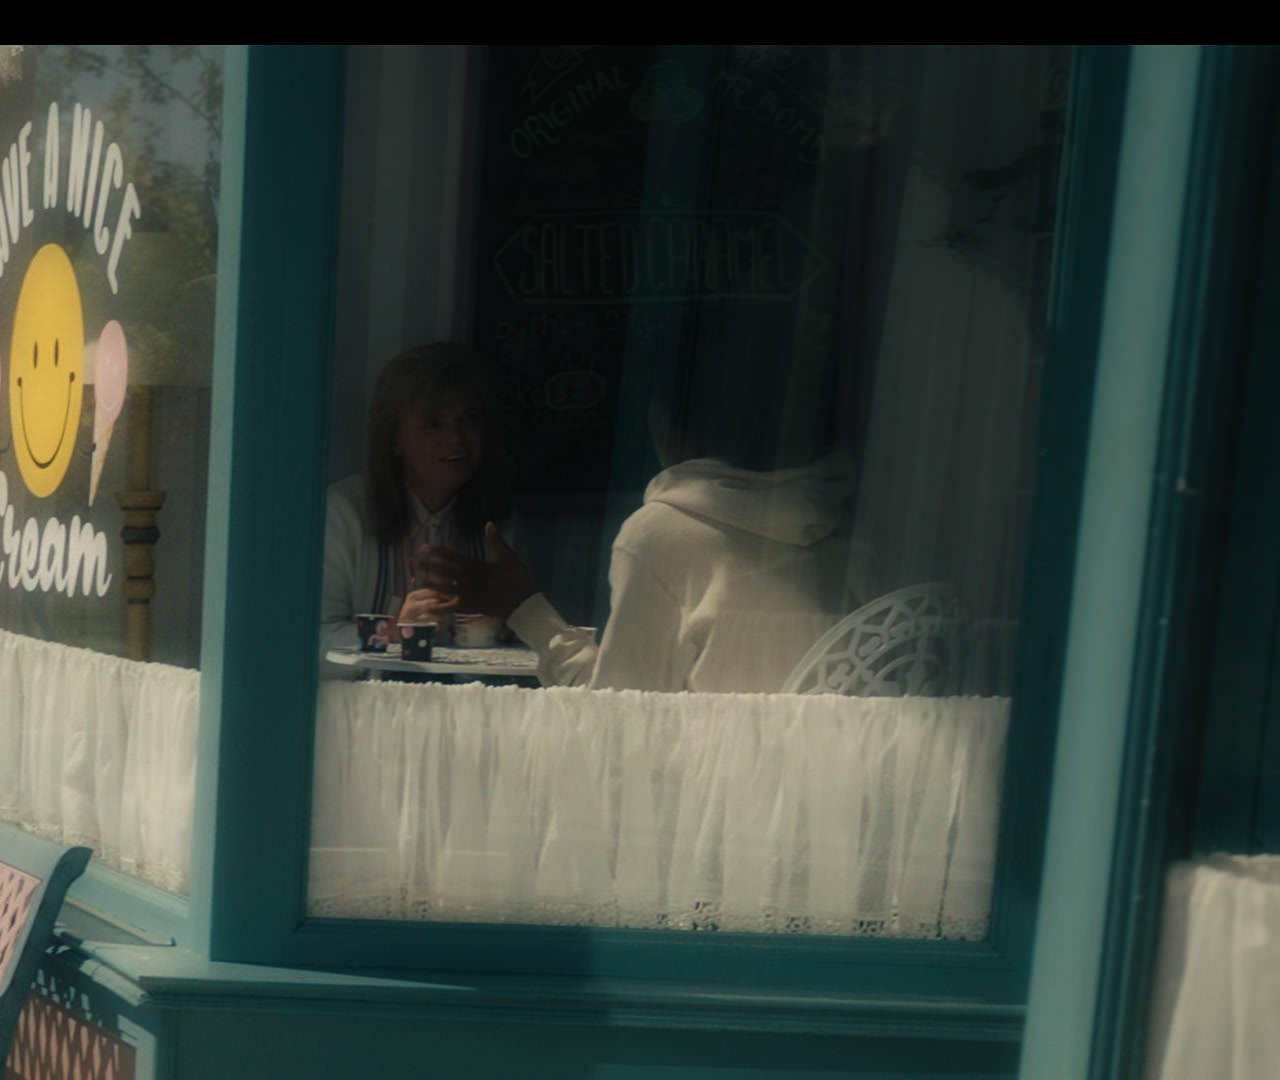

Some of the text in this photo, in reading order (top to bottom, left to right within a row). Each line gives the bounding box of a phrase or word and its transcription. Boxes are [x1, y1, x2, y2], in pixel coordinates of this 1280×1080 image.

[510, 65, 632, 158] ORIGINAL
[43, 102, 59, 209] A
[66, 102, 141, 295] NICE
[518, 221, 640, 295] SALTED
